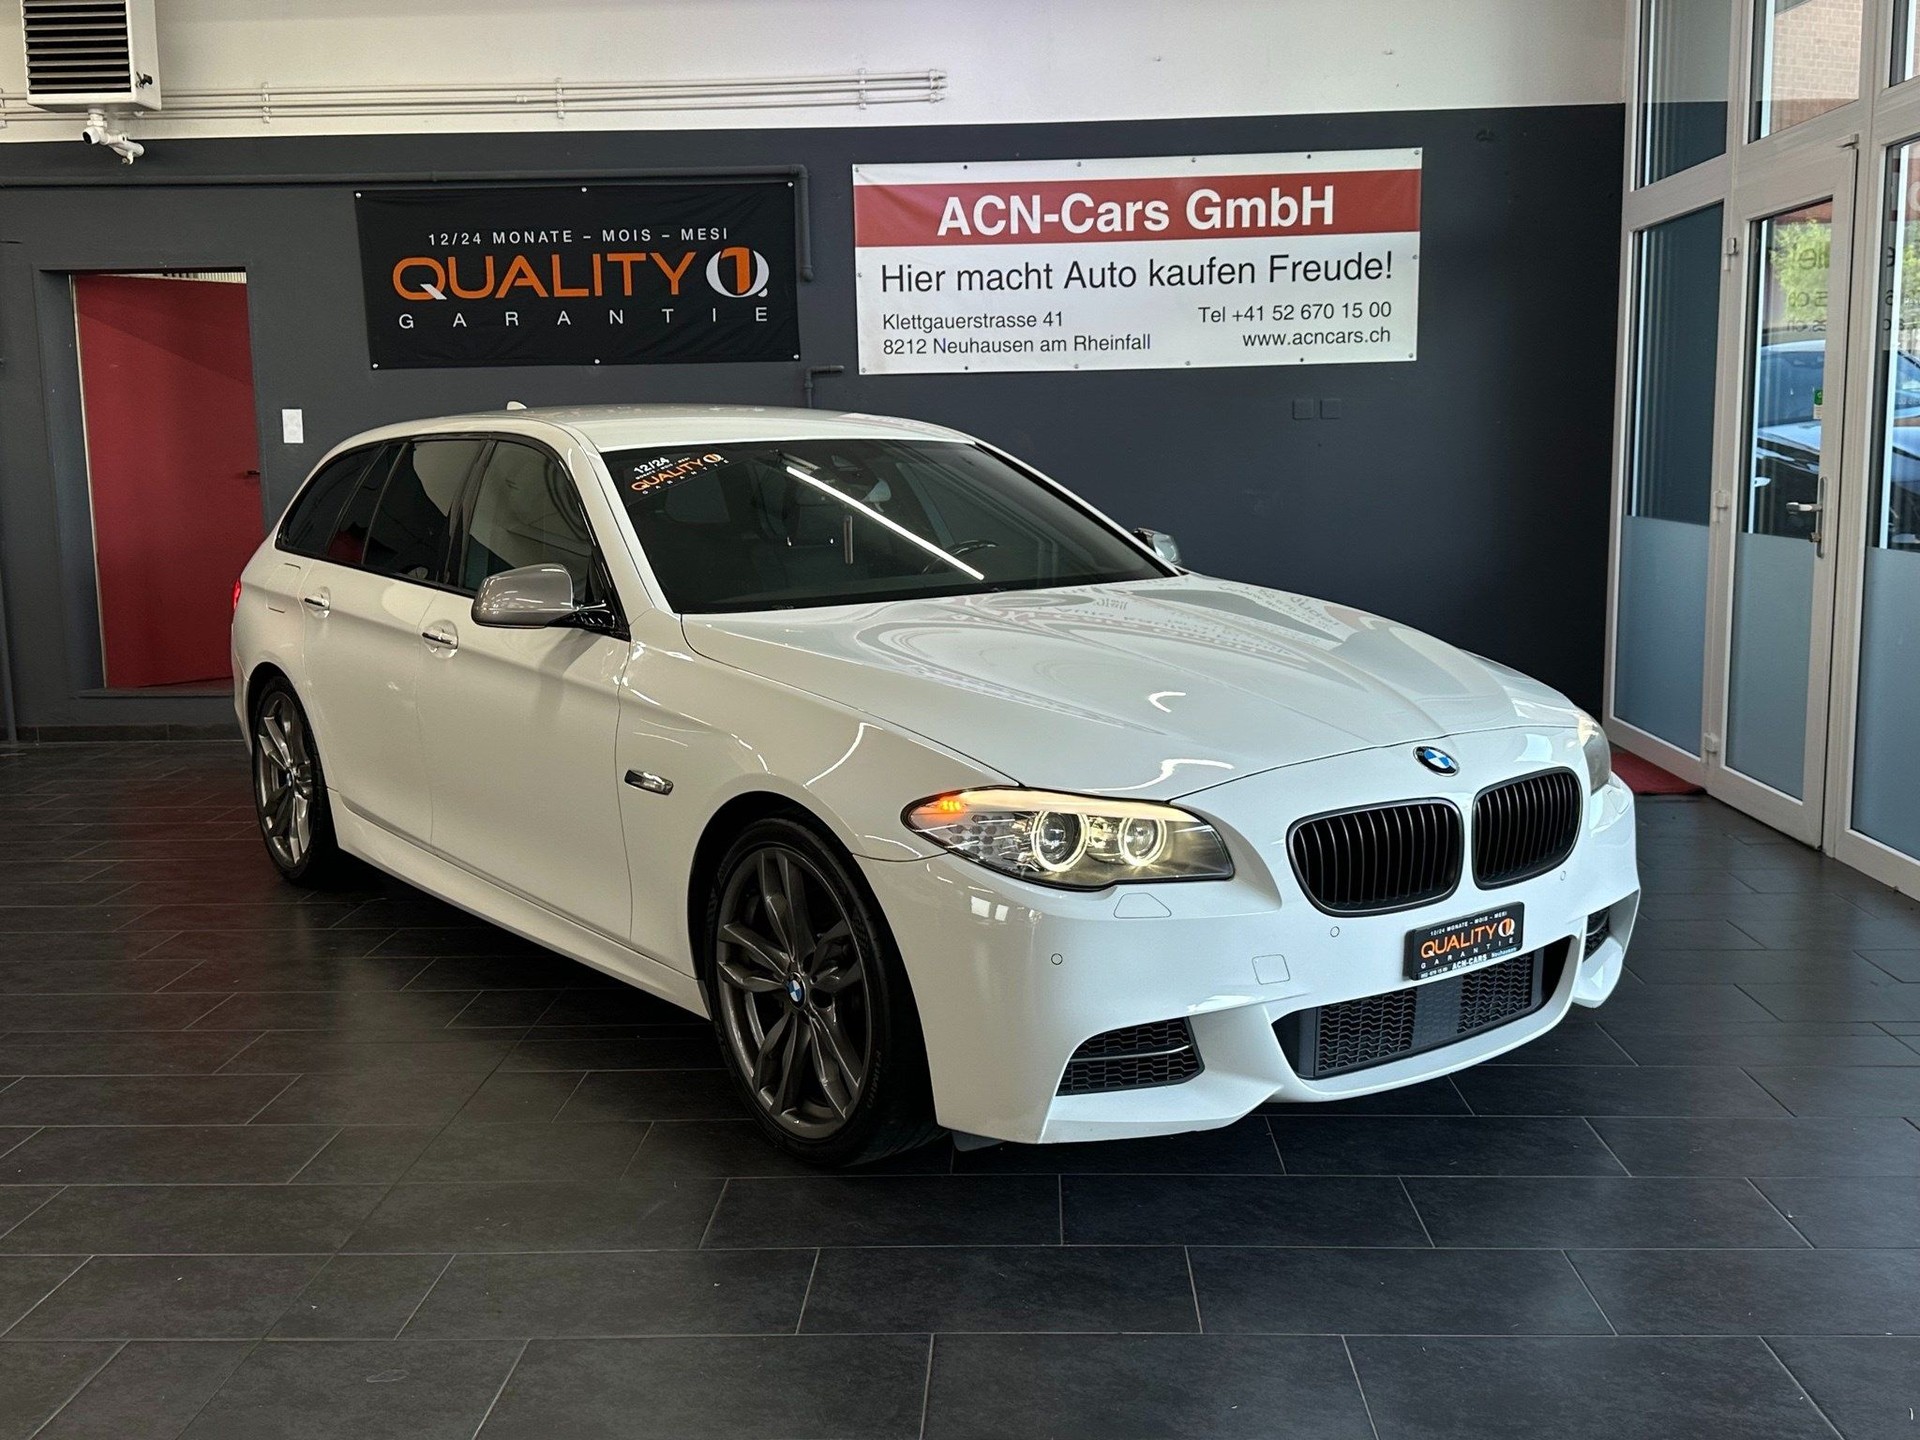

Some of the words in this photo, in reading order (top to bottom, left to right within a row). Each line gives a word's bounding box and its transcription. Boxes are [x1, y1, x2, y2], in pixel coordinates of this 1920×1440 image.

[936, 191, 1170, 236] ACN-Cars
[1185, 185, 1334, 230] GmbH
[428, 232, 482, 246] 12/24
[492, 230, 573, 244] MONATE
[602, 228, 651, 242] MOIS
[681, 227, 727, 241] MESI
[392, 251, 696, 301] QUALITY
[881, 264, 946, 293] Hier
[957, 261, 1053, 291] macht
[1063, 260, 1137, 289] Auto
[1149, 256, 1255, 287] kaufen
[1269, 250, 1392, 283] Freude!
[398, 306, 768, 329] GARANTIE
[883, 312, 1036, 334] Klettgauerstrasse
[1042, 311, 1063, 327] 41
[1198, 306, 1226, 323] Tel
[1232, 305, 1263, 322] +41
[1272, 304, 1295, 321] 52
[1300, 303, 1335, 320] 670
[1342, 302, 1363, 319] 15
[1369, 301, 1392, 318] 00
[883, 338, 927, 355] 8212
[933, 336, 1034, 354] Neuhausen
[1039, 339, 1067, 352] am
[1074, 333, 1151, 352] Rheinfall
[1242, 326, 1391, 347] www.acncars.ch
[631, 458, 704, 491] QUALITY
[634, 457, 670, 474] 12/24
[1421, 922, 1498, 958] QUALITY
[1421, 937, 1514, 969] GARANTIE
